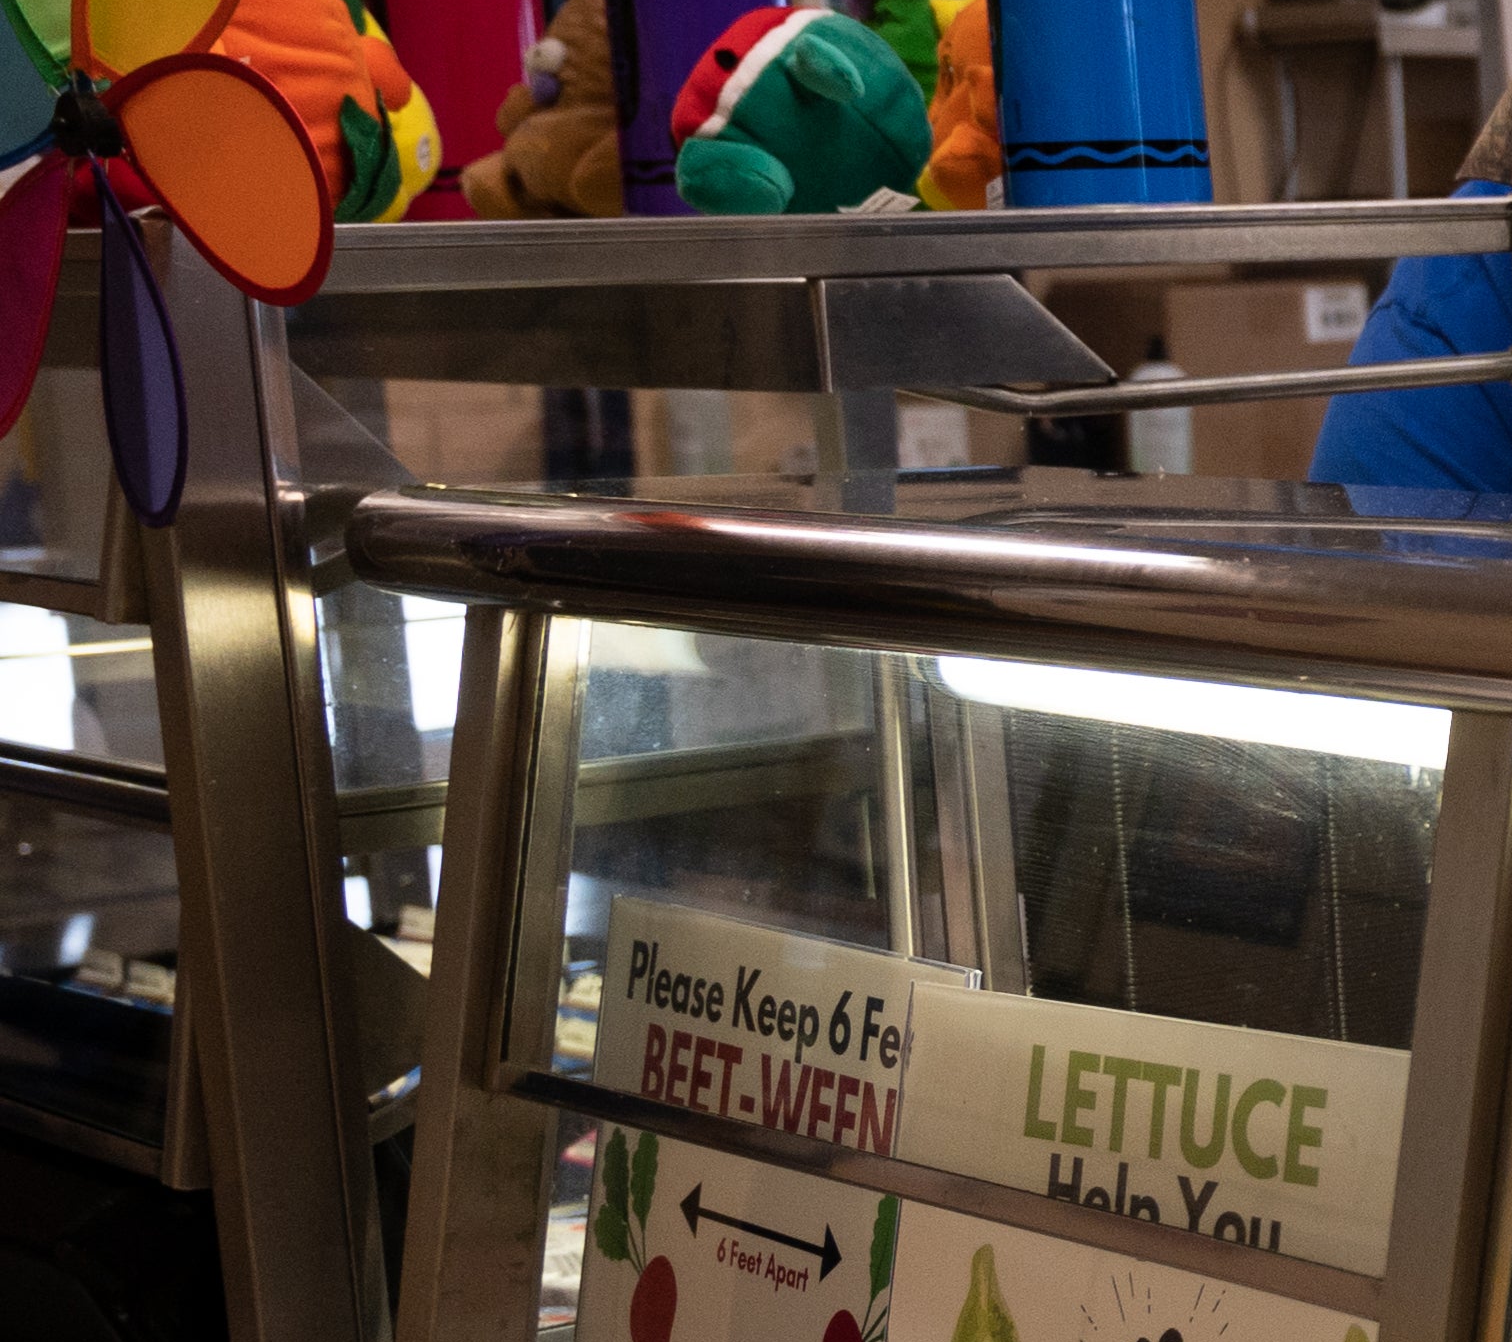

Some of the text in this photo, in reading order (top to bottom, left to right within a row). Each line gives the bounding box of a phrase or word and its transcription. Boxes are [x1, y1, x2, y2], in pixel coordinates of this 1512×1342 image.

[626, 939, 724, 1023] Please
[731, 965, 820, 1064] Keep
[828, 990, 853, 1055] 6
[1023, 1043, 1329, 1187] LETTUCE
[716, 1237, 809, 1292] 6 Feet Apart
